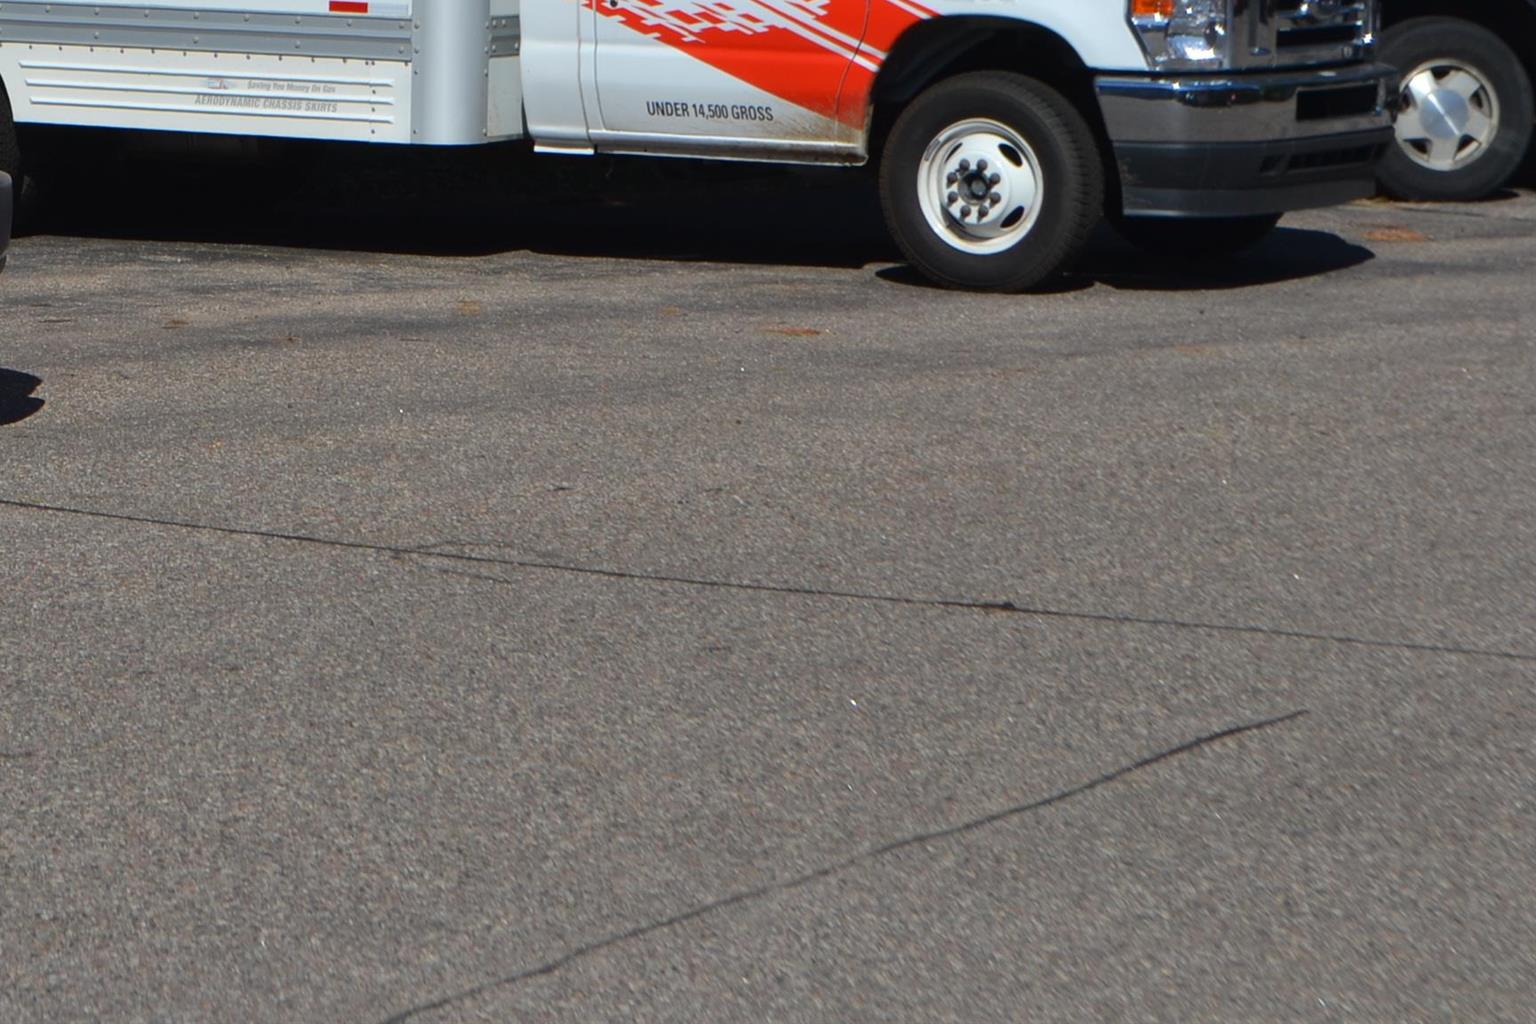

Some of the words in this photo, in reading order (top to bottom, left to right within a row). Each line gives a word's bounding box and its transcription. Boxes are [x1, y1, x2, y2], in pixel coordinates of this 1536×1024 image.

[194, 94, 263, 109] AERODYNAMIC
[263, 97, 303, 112] CHASSIS
[305, 100, 338, 113] SKIRTS
[646, 101, 690, 117] UNDER
[692, 103, 729, 120] 14,500
[731, 105, 774, 122] GROSS
